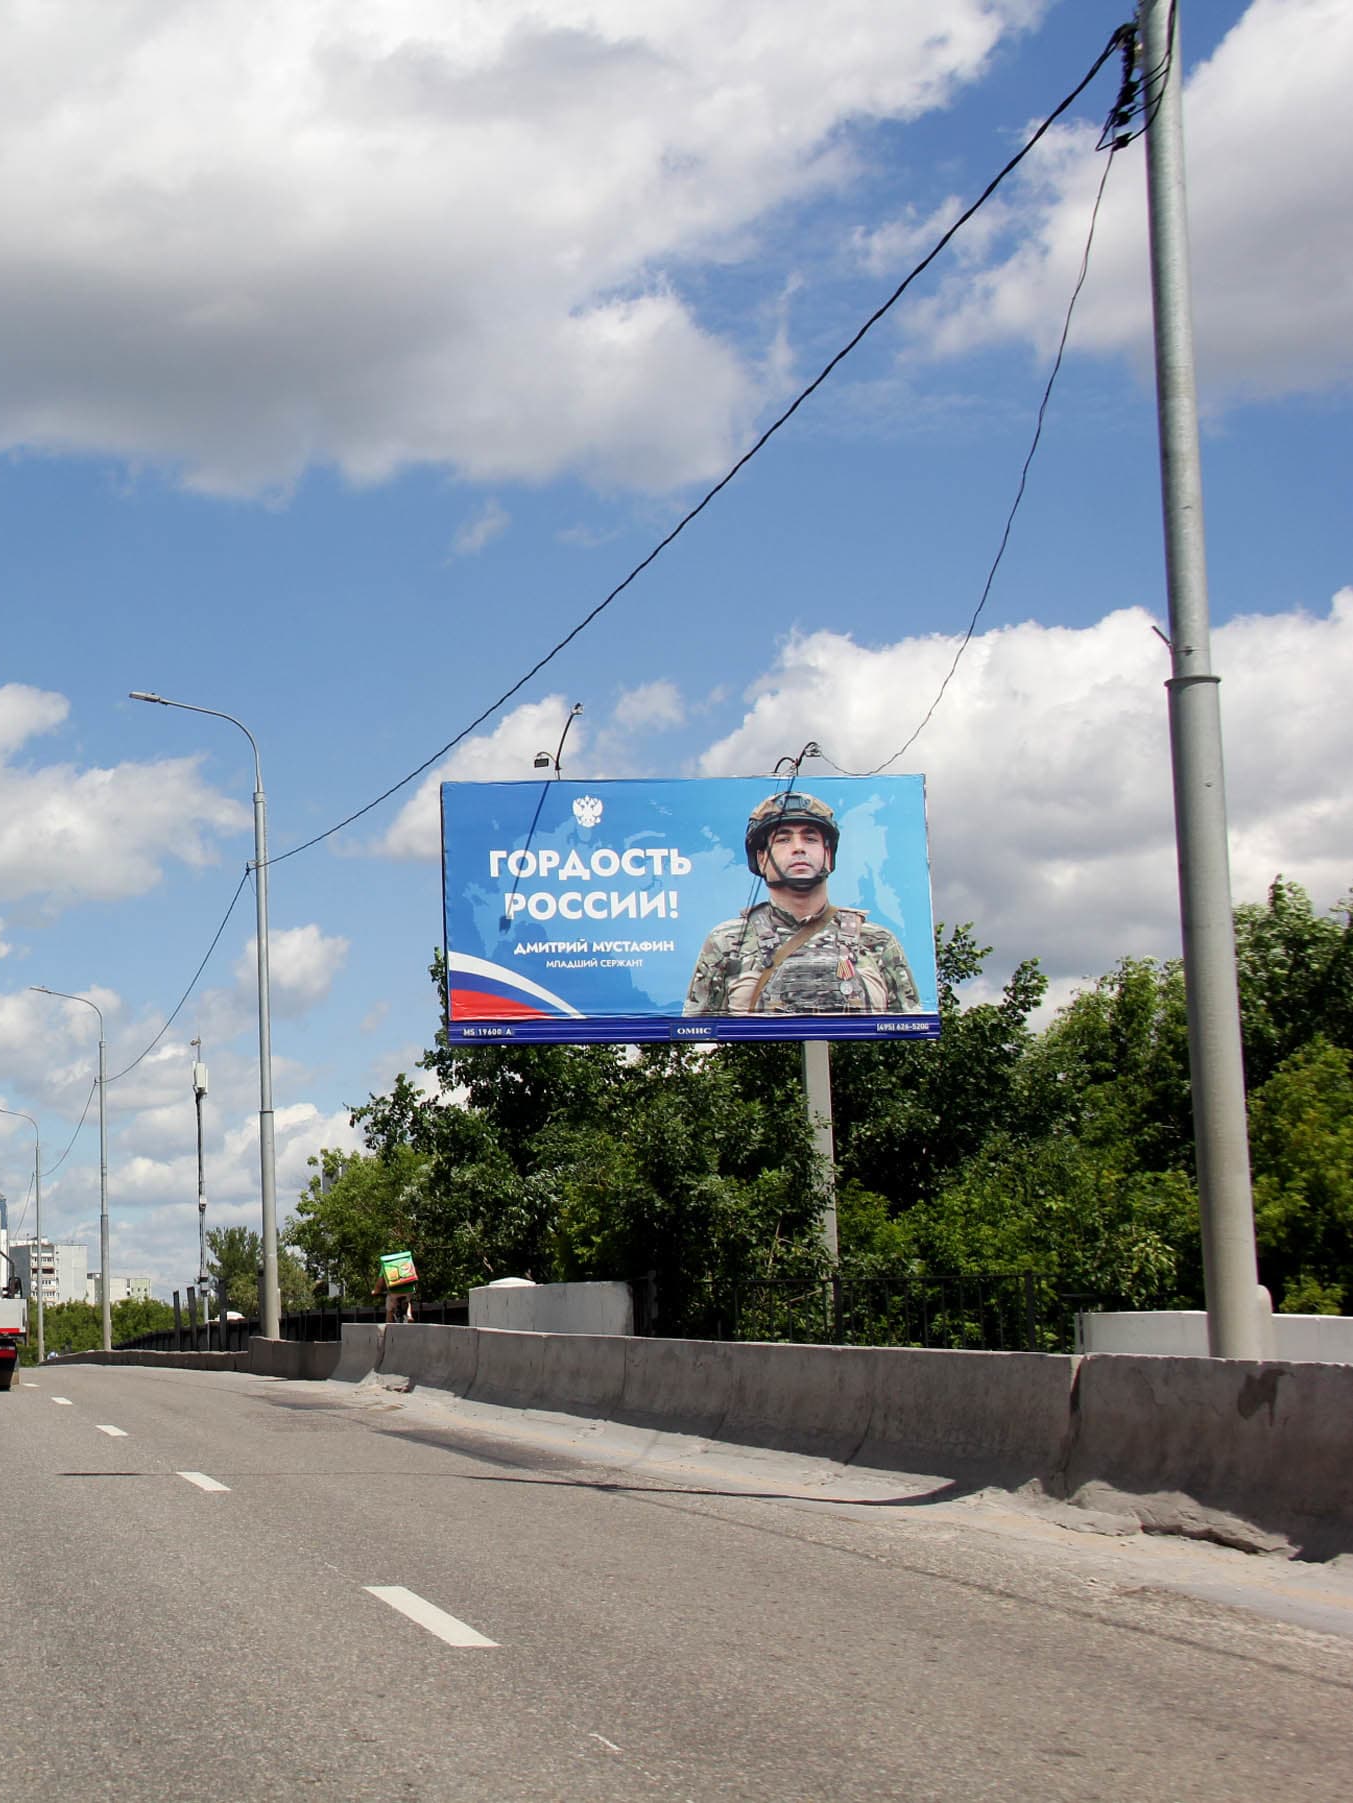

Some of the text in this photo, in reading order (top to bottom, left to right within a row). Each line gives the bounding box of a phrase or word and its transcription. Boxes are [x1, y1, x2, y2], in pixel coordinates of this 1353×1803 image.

[489, 848, 692, 881] ГОРДОСТЬ
[504, 890, 679, 920] РОССИИ!
[513, 938, 675, 955] ДМИТРИЙ МУСТАФИН
[545, 957, 644, 969] МЛАДШИЙ СЕРЖАНТ
